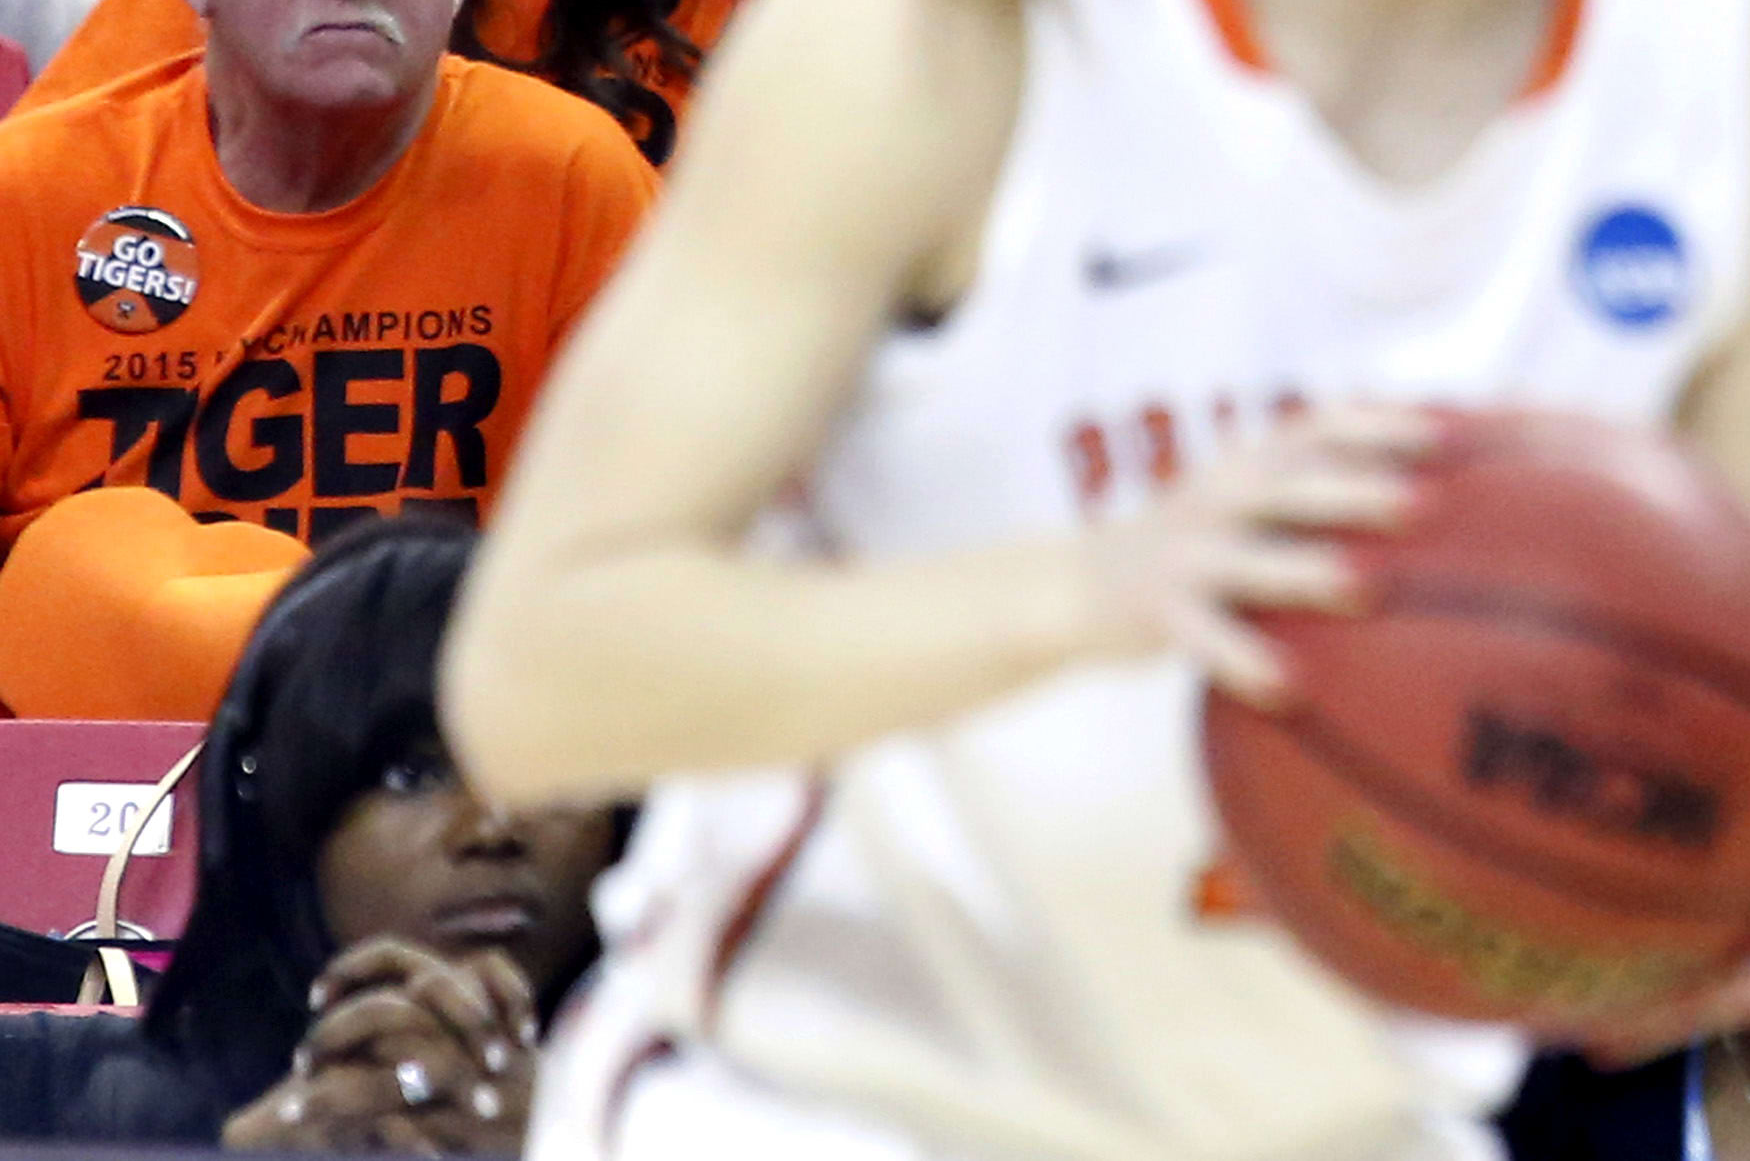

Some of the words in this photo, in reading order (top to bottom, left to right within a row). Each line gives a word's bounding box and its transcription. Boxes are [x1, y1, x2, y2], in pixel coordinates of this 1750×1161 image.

[113, 235, 162, 267] GO
[78, 250, 197, 305] TIGERS!
[104, 351, 196, 381] 2015
[77, 343, 500, 503] TIGER
